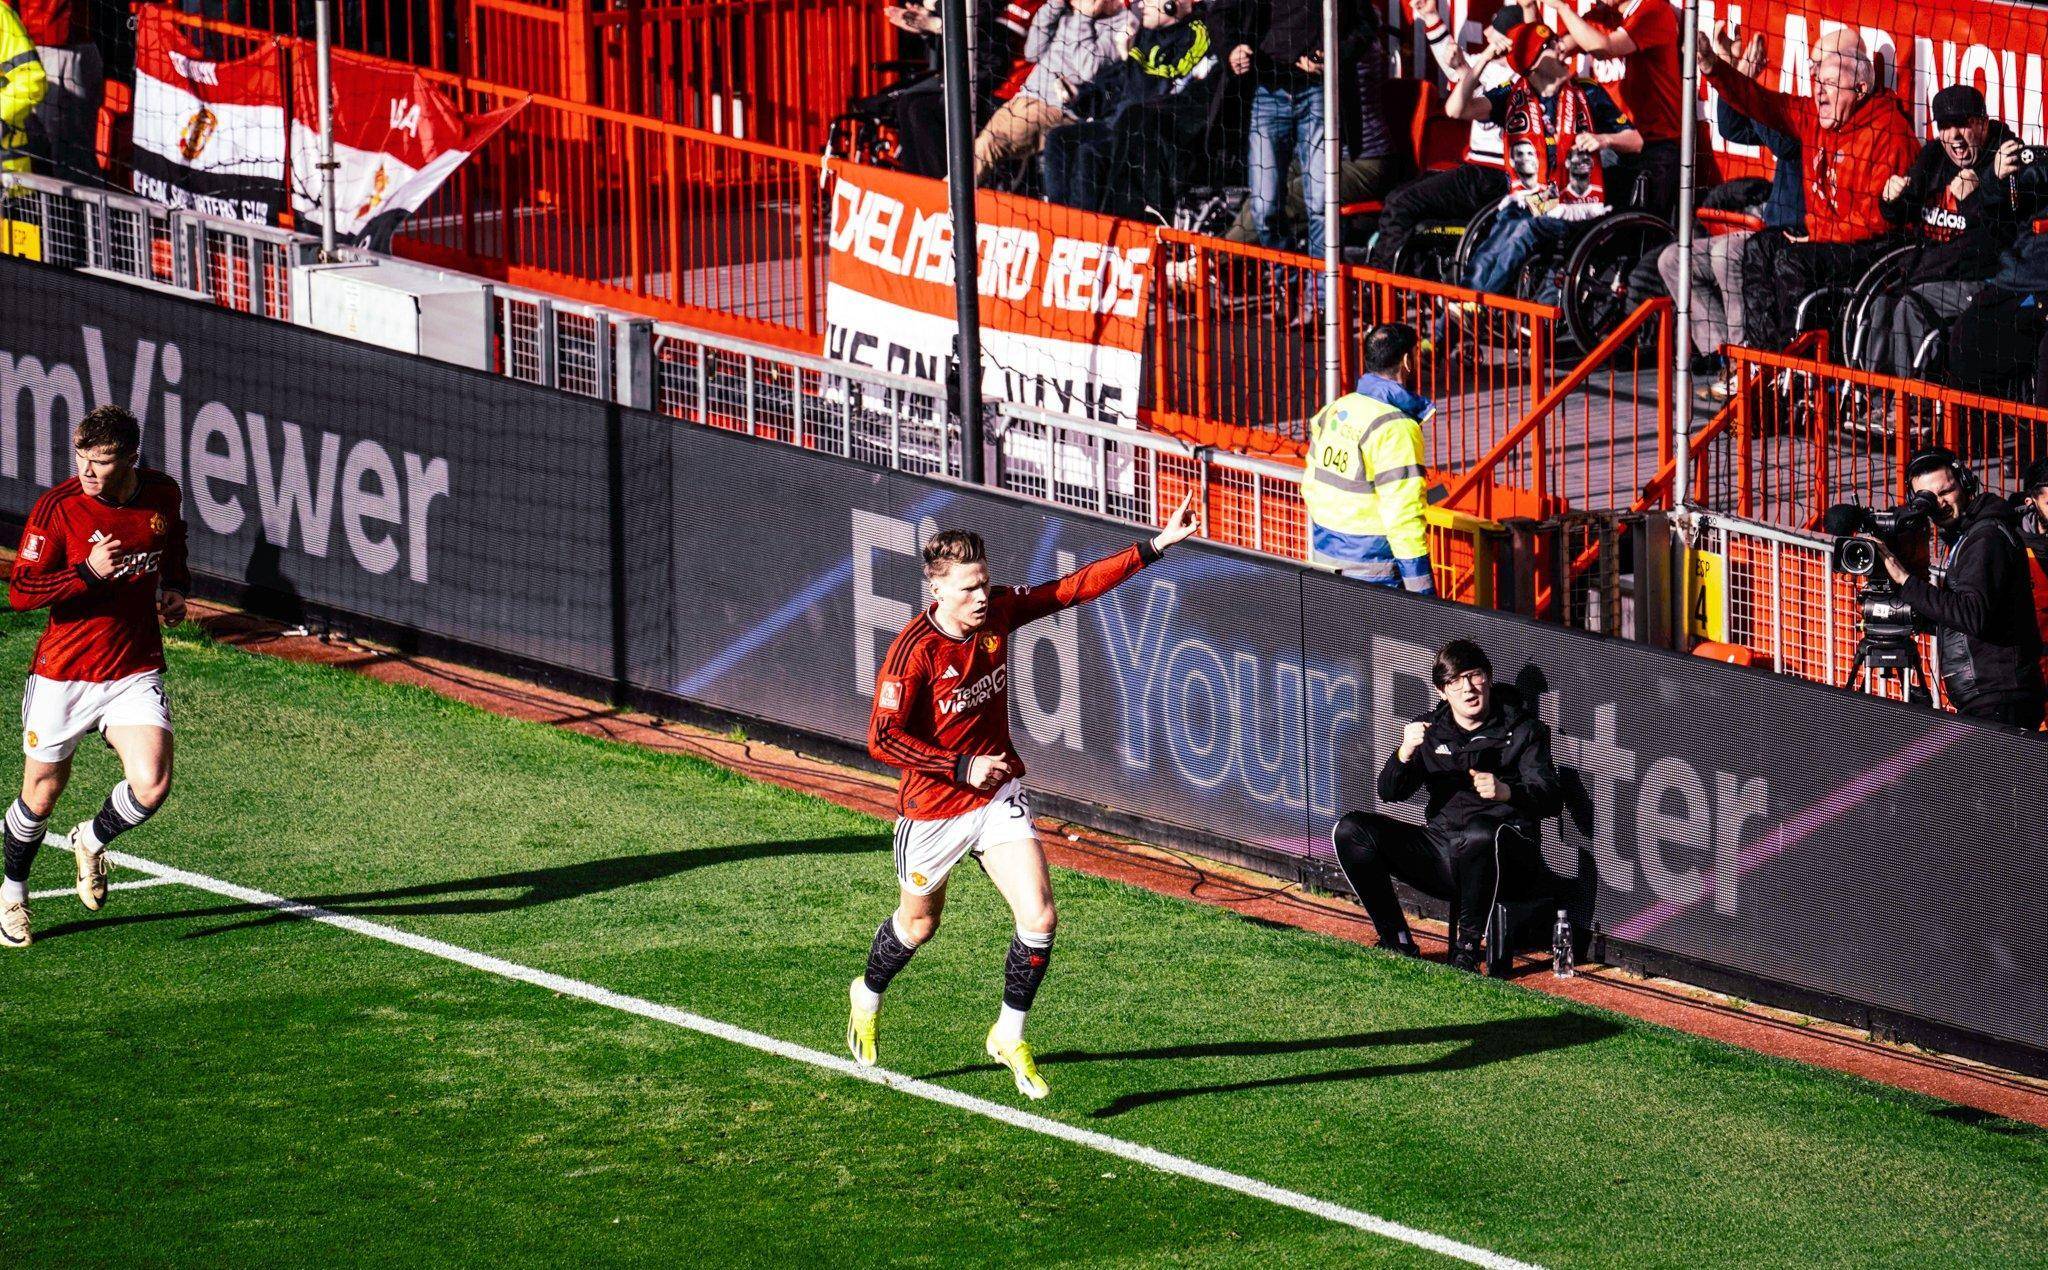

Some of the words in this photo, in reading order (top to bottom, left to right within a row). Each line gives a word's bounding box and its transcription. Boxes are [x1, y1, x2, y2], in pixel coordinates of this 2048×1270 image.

[1914, 35, 2043, 147] NOW
[829, 177, 1040, 301] CHELMSORD
[1042, 236, 1151, 318] REDS
[1323, 446, 1349, 473] 048
[1694, 585, 1708, 630] 4
[851, 508, 1084, 750] Fd
[1096, 579, 1358, 816] Your
[938, 688, 993, 715] Viewer
[952, 674, 993, 701] Team
